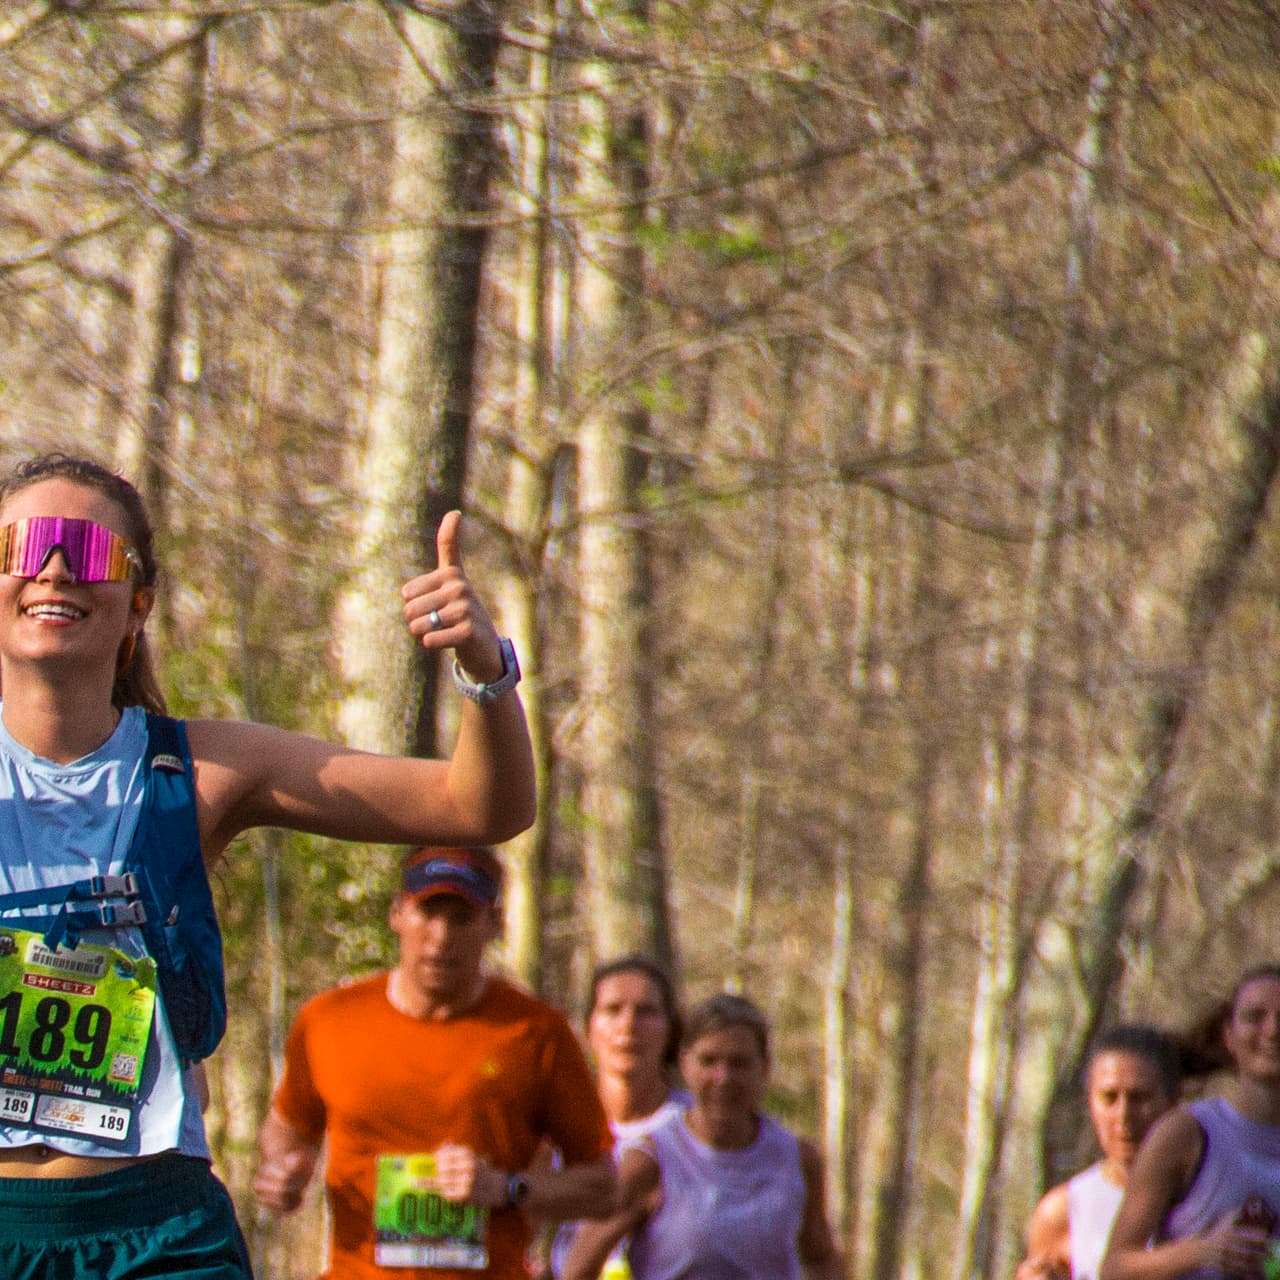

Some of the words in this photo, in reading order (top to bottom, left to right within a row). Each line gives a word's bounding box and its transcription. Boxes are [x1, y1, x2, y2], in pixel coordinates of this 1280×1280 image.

[27, 975, 93, 995] SHEETZ
[3, 1097, 29, 1114] 189
[99, 1114, 125, 1132] 189
